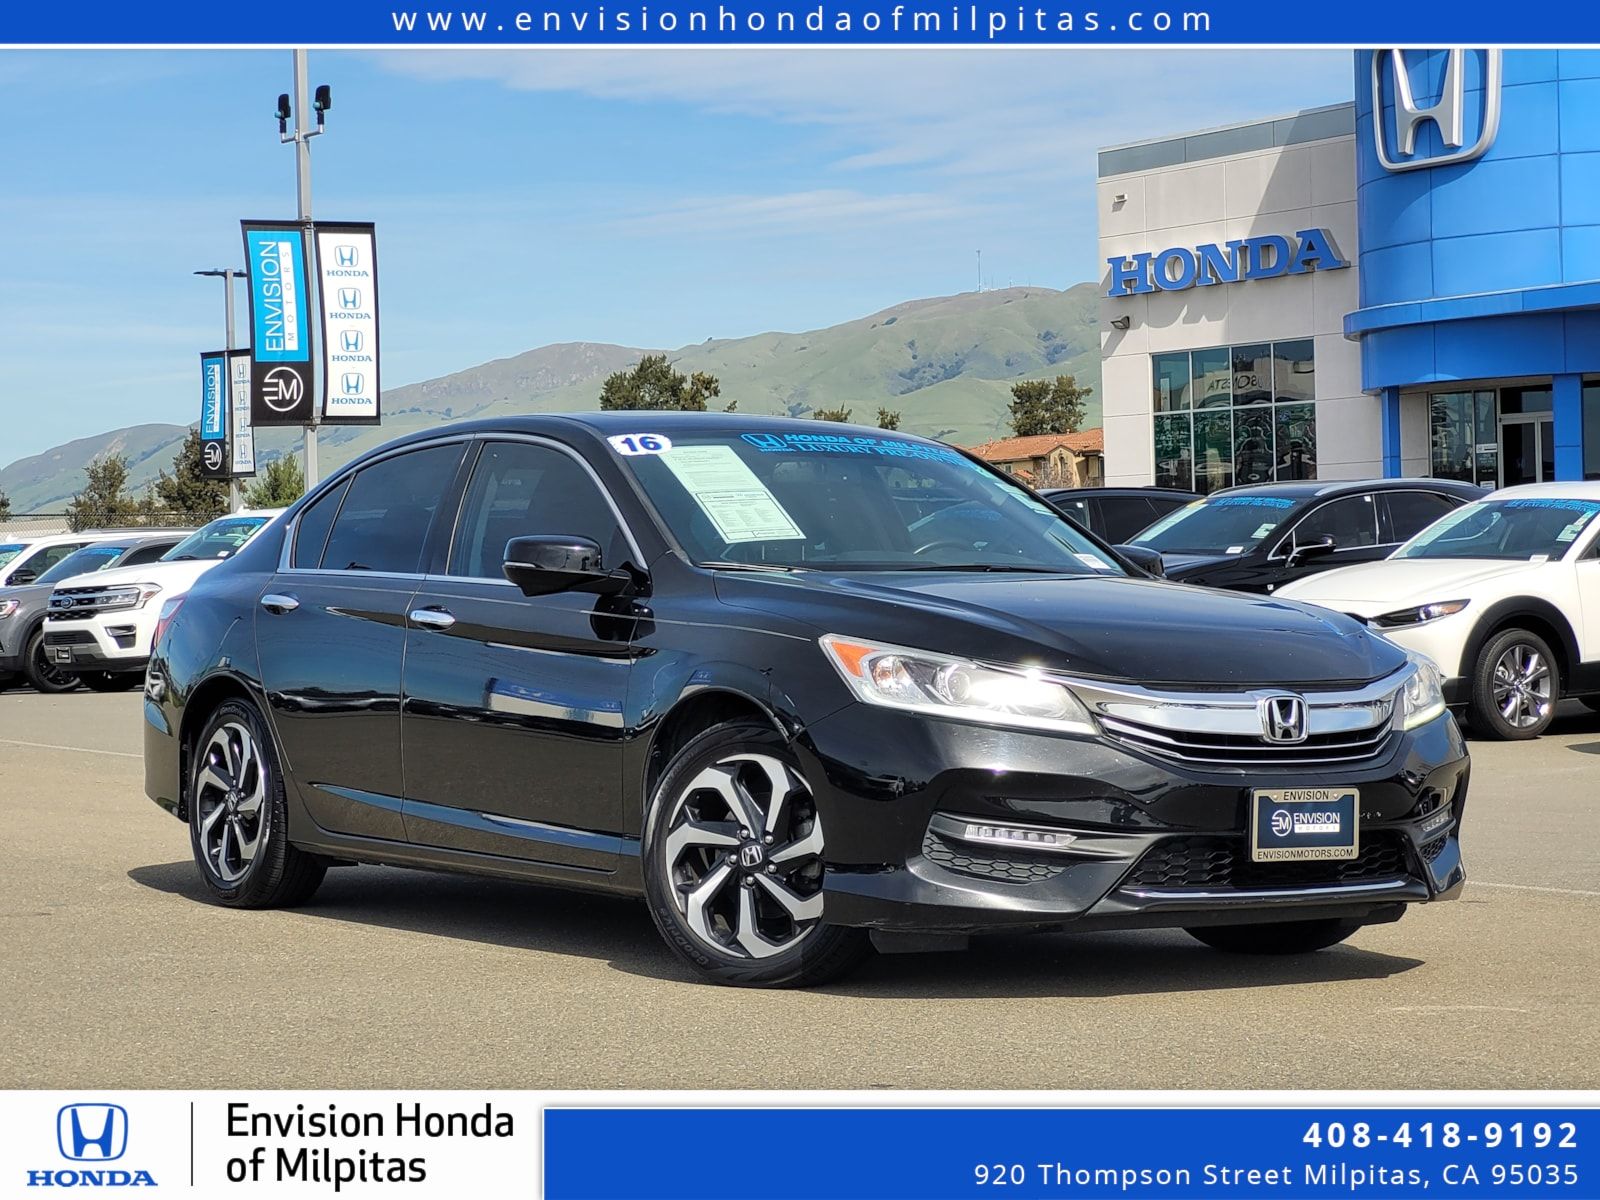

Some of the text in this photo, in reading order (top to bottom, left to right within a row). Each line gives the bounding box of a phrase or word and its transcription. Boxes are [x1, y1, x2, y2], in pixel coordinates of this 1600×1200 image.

[1107, 228, 1344, 297] HONDA
[258, 241, 284, 351] ENVISION
[281, 251, 295, 342] MOTORS
[205, 364, 216, 433] ENVISION
[620, 436, 663, 452] 16
[783, 434, 849, 444] HONDA
[853, 437, 878, 447] OF
[800, 443, 873, 455] LUXURY
[1283, 790, 1330, 801] ENVISION
[1293, 811, 1340, 825] ENVISION
[1257, 848, 1354, 860] ENVISIONMOTORS.COM
